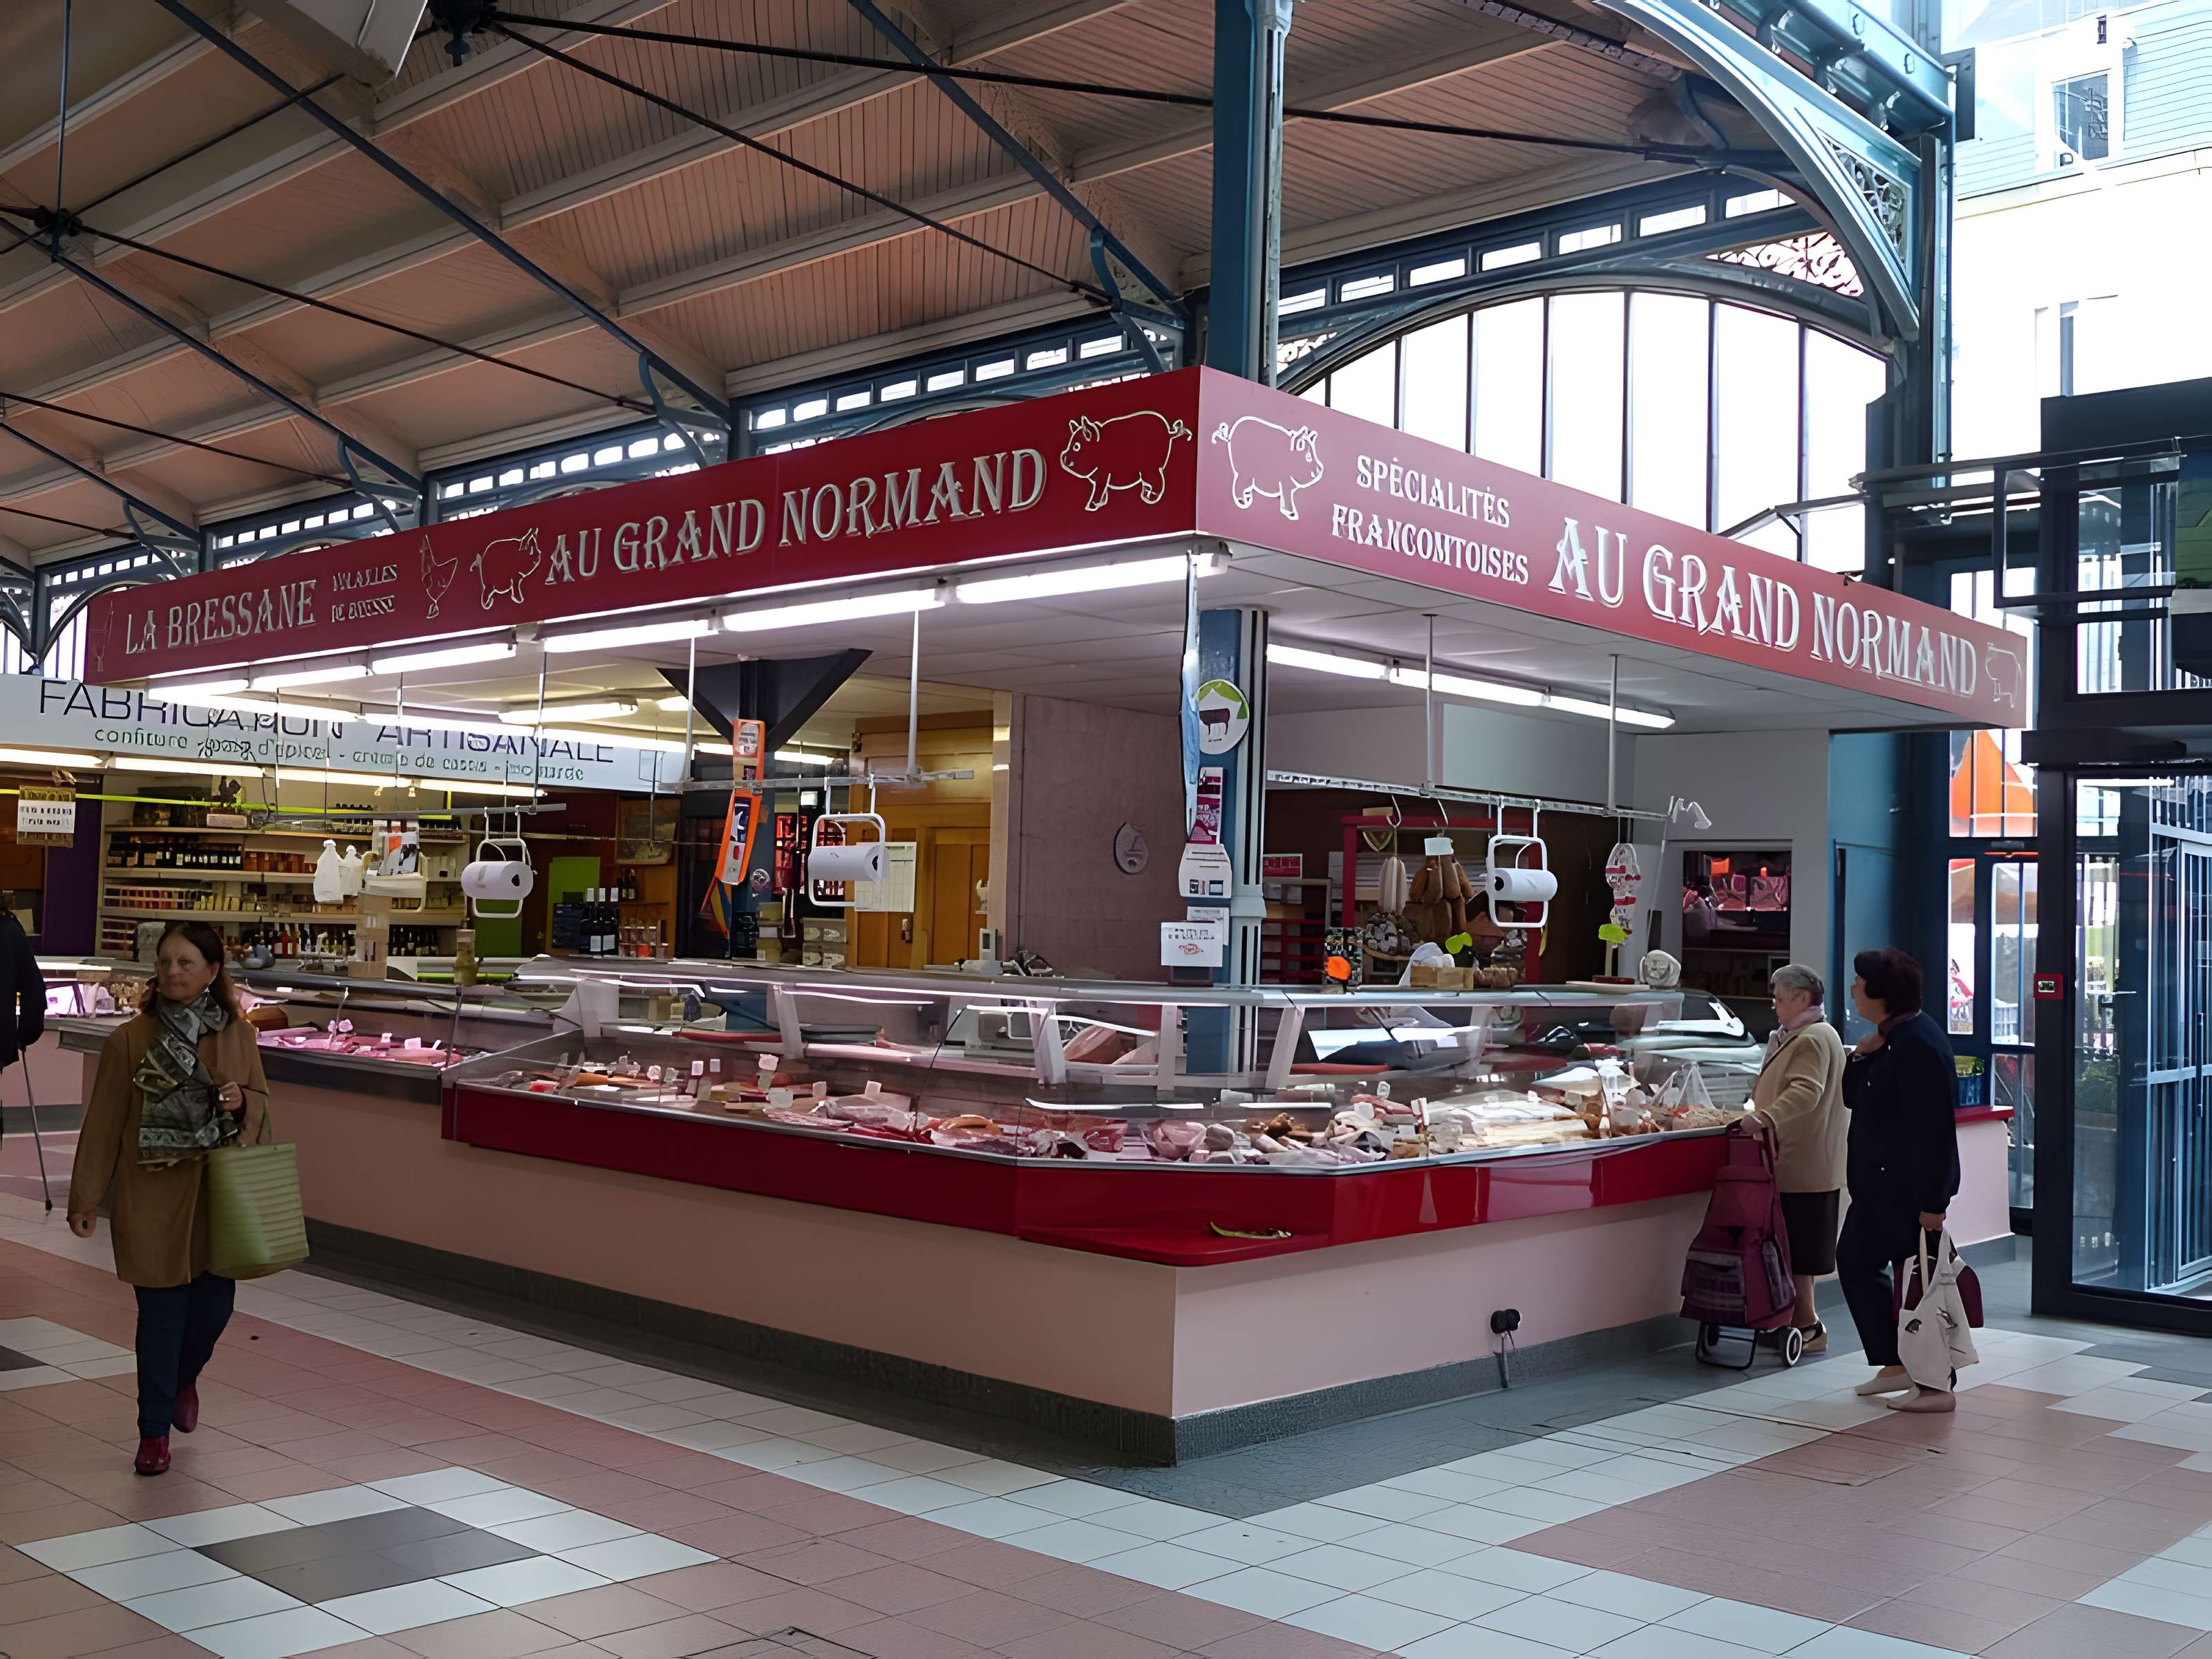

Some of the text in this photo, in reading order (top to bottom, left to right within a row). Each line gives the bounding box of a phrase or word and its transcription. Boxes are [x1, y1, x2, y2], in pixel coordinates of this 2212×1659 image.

[545, 448, 1047, 585] AU GRAND NORMAND
[1331, 503, 1529, 585] FRANCOMTOISES
[125, 579, 317, 655] LA BRESSANE
[1548, 516, 1977, 698] AU GRAND NORMAND
